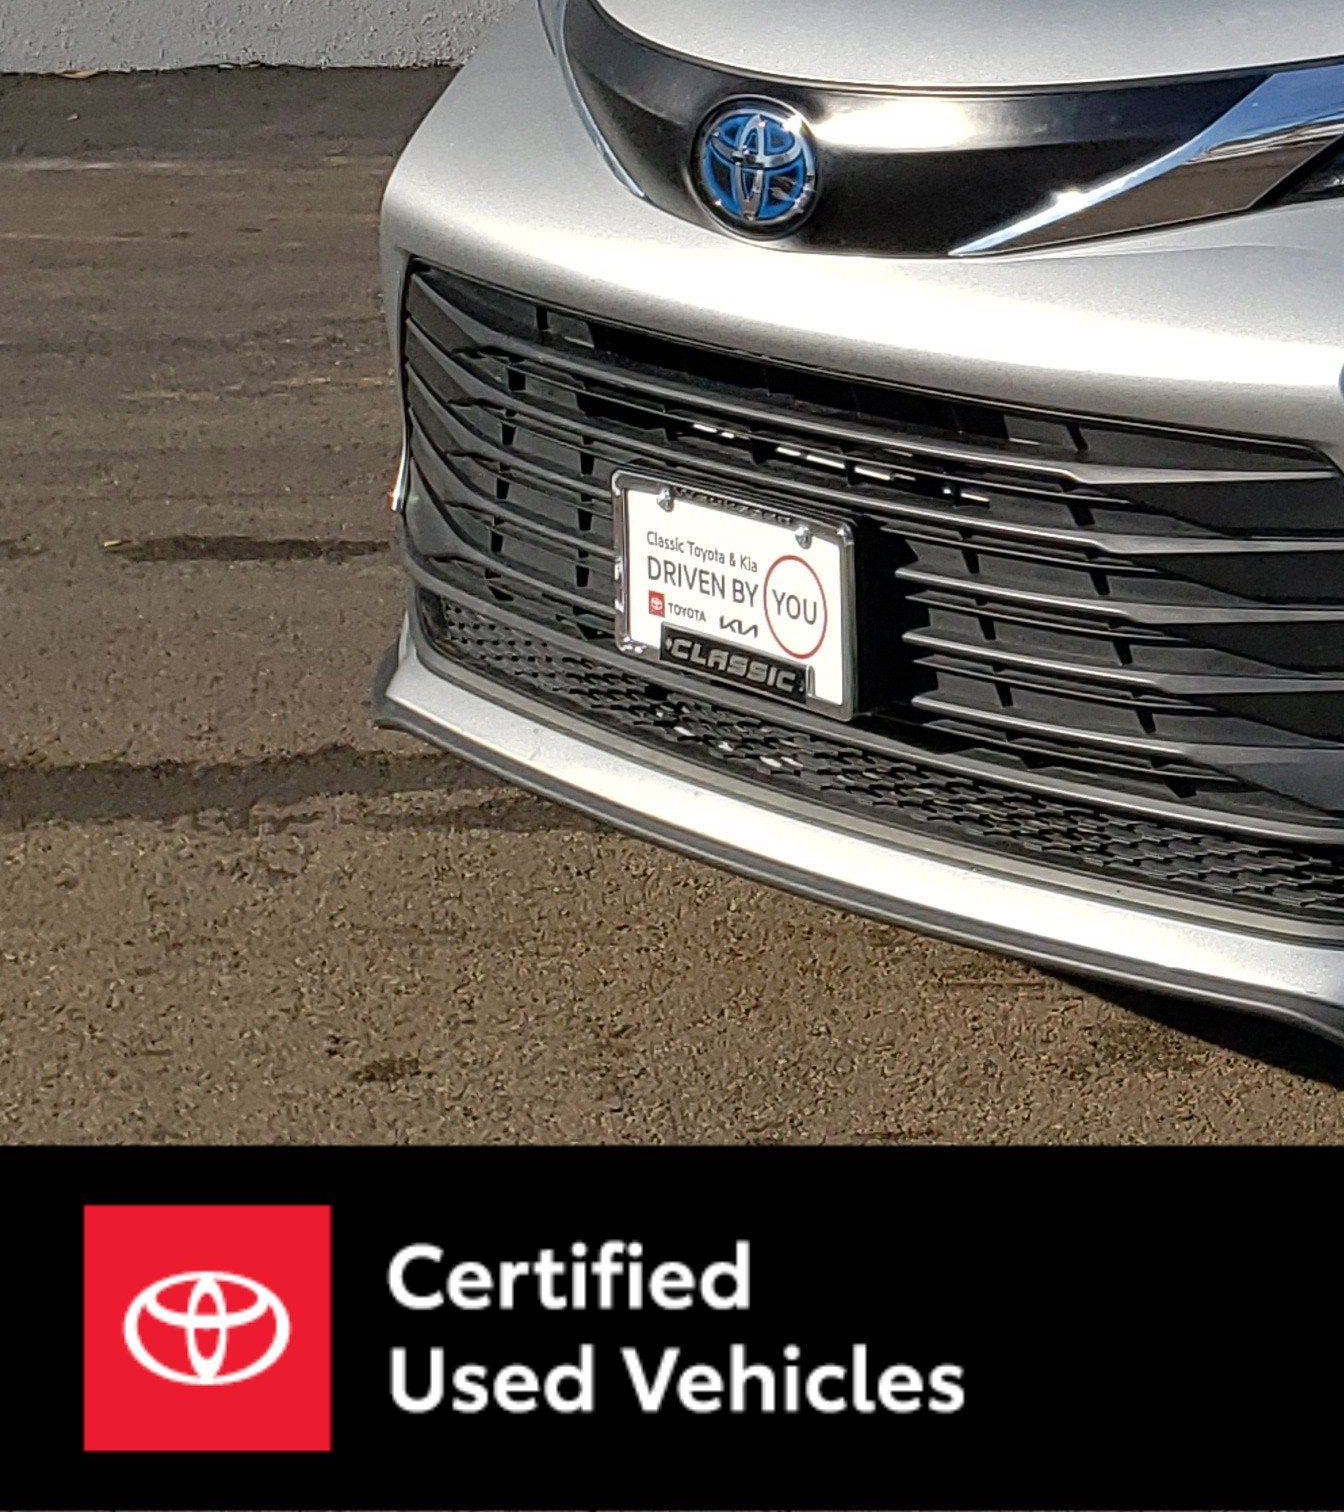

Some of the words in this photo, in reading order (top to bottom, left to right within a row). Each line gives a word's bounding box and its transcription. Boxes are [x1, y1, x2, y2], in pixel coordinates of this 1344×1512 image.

[646, 531, 685, 553] Classic
[686, 540, 725, 565] Toyota
[729, 552, 736, 567] &
[740, 554, 758, 573] Kia
[647, 555, 726, 600] DRIVEN
[732, 578, 759, 607] BY
[772, 589, 817, 625] YOU
[667, 602, 706, 623] TOYOTA
[670, 638, 797, 692] CLASSIC
